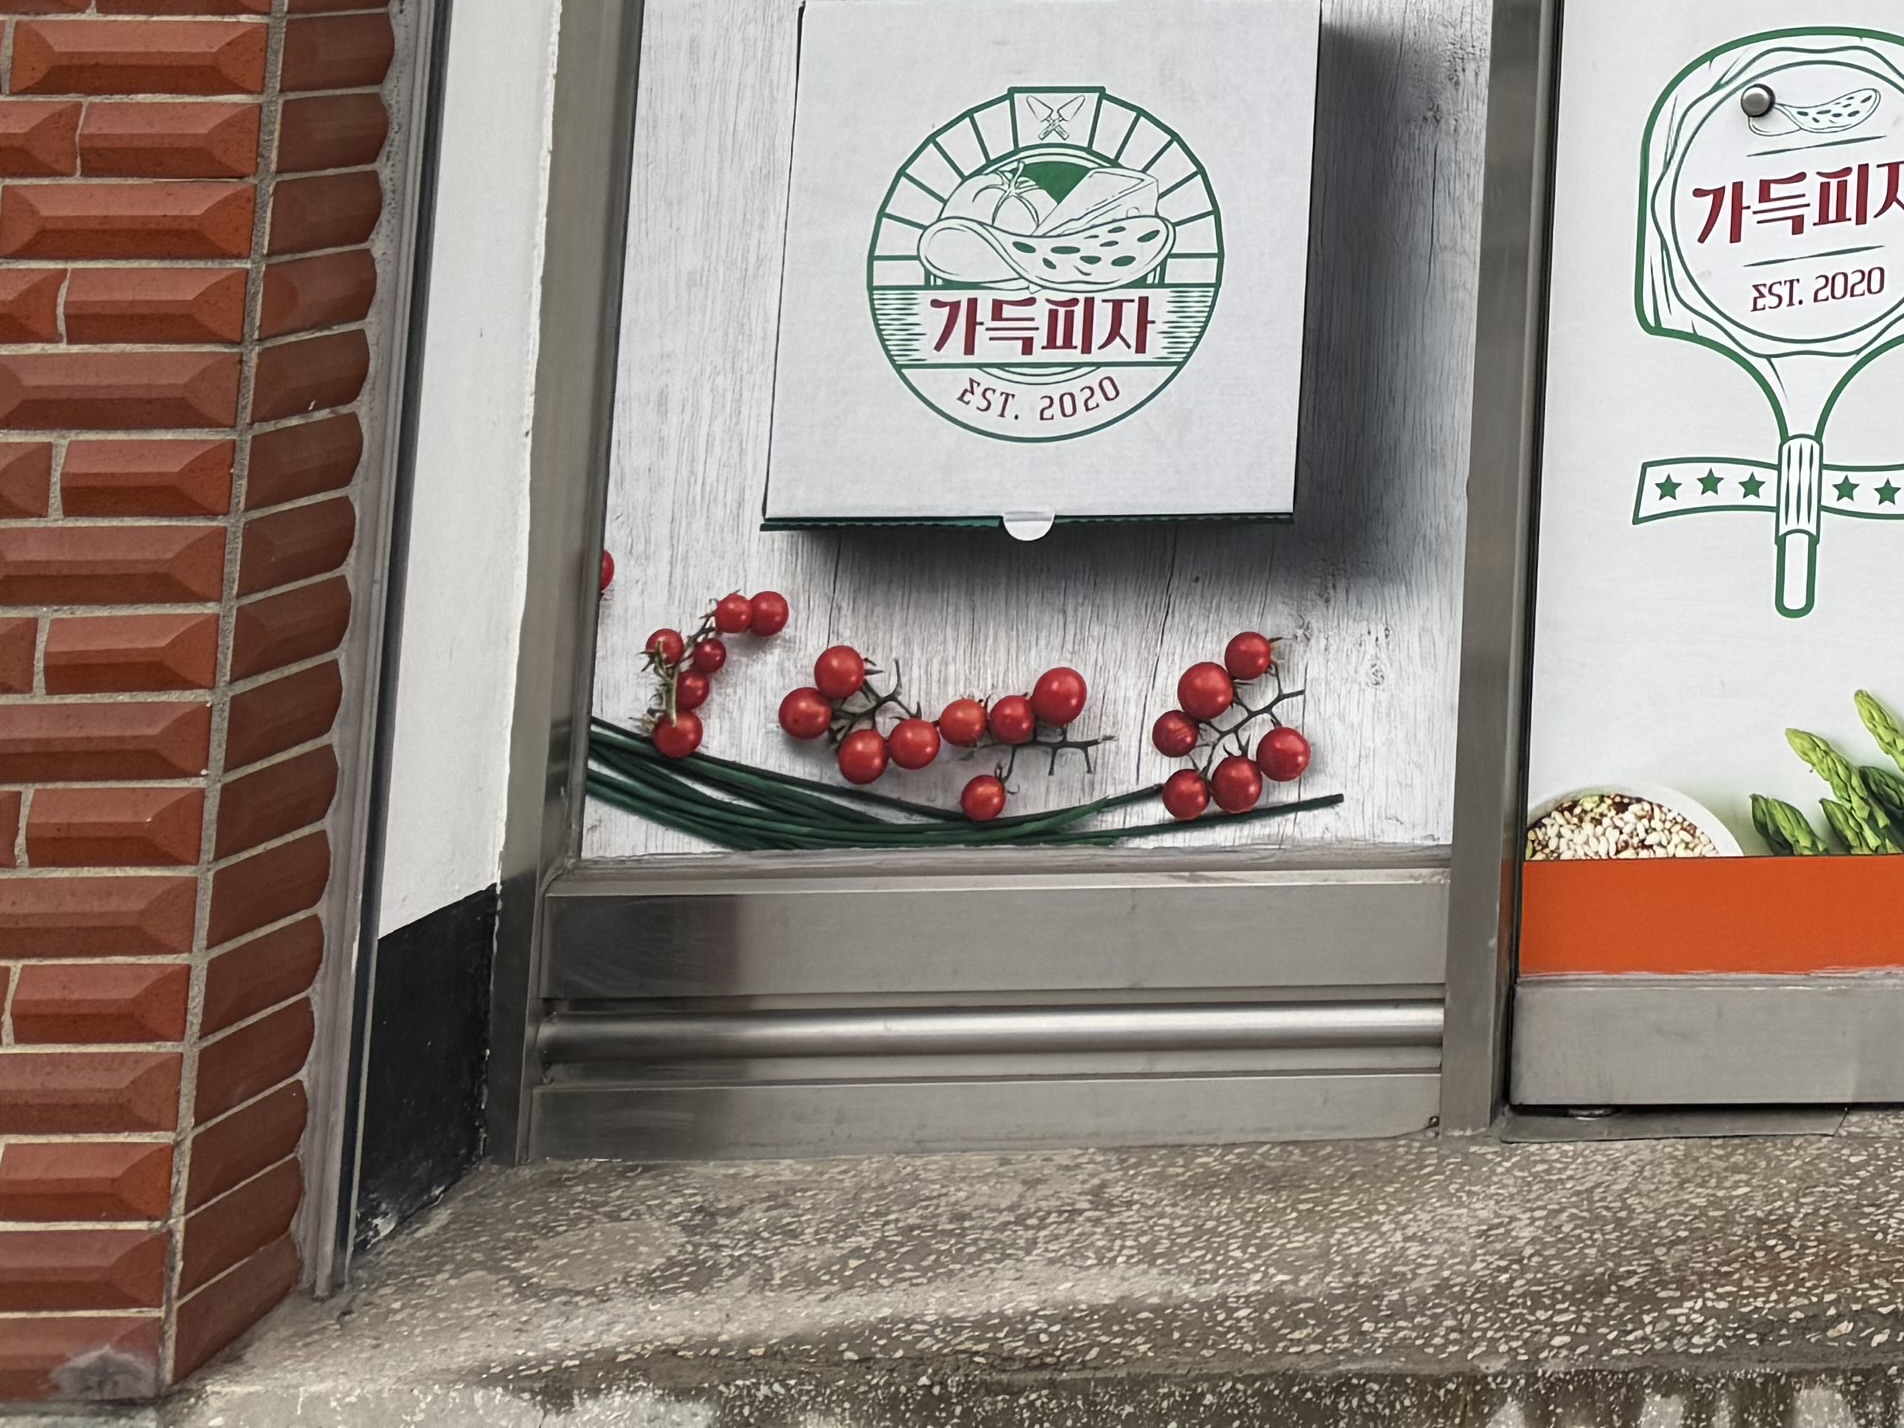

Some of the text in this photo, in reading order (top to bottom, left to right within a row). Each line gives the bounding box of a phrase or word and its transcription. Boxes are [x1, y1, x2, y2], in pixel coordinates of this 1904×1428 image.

[1750, 266, 1885, 312] EST. 2020
[929, 295, 1156, 356] 가득피자
[956, 374, 1121, 421] EST. 2020
